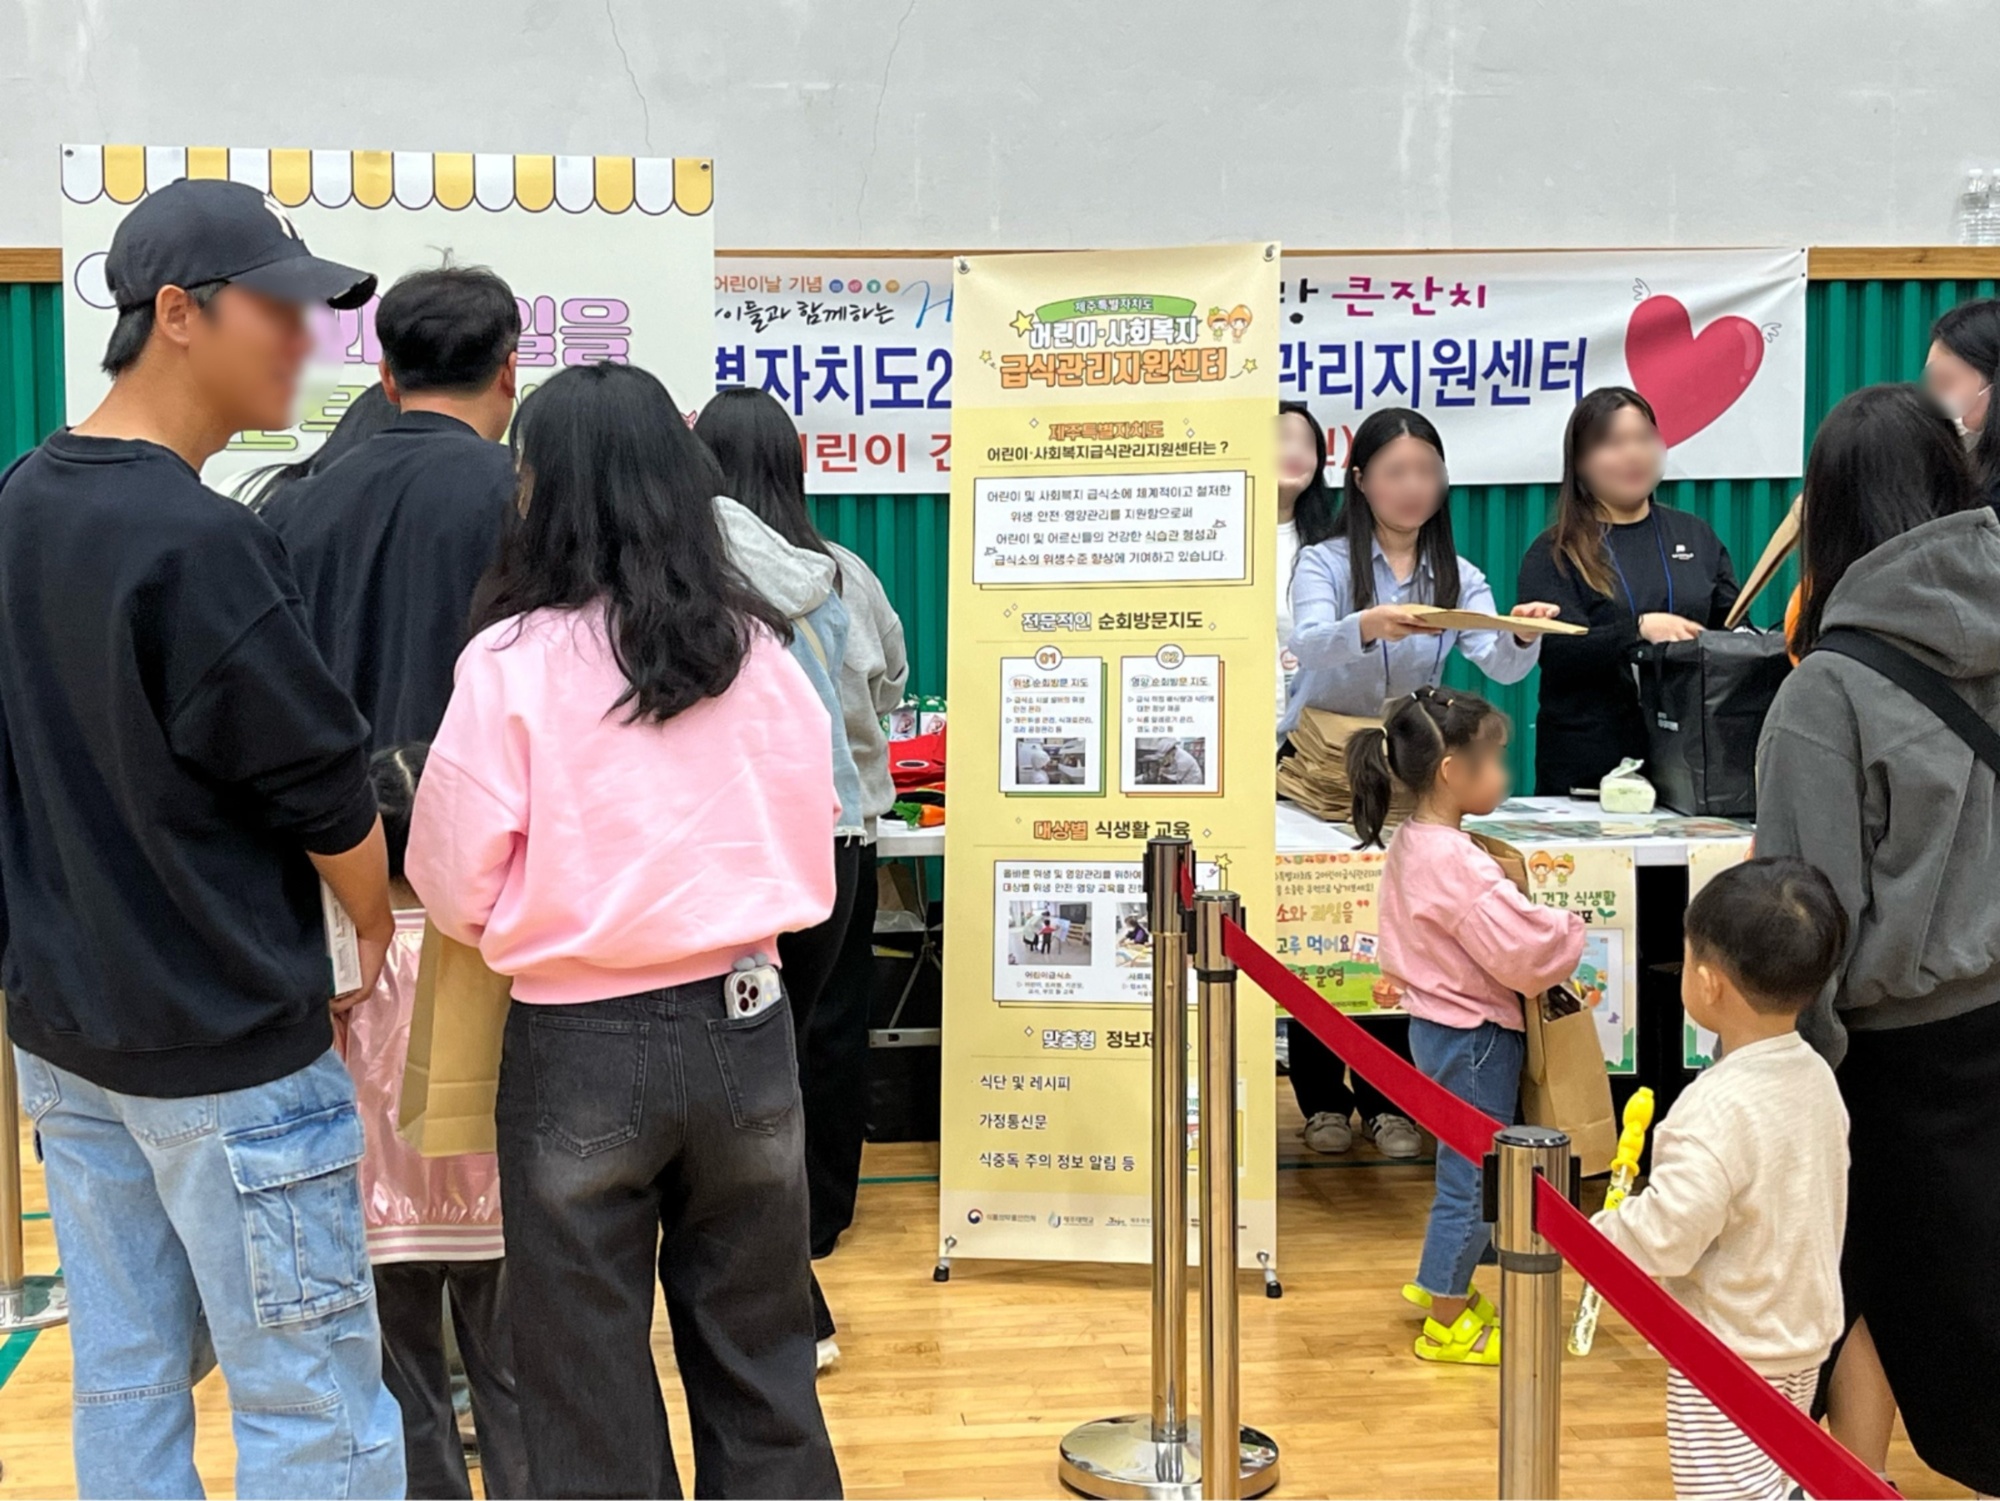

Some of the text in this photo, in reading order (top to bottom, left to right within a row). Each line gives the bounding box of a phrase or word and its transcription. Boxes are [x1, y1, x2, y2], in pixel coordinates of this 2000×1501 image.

[715, 275, 823, 293] 어린이날 기념
[1331, 276, 1487, 317] 큰잔치
[715, 300, 895, 333] 이들과 함께하는
[999, 346, 1229, 389] 급식관리지원센터
[1049, 420, 1165, 441] 제주특별자치도
[987, 485, 1231, 502] 어린이 및 사회복지 급식소에 체계적이고 철저한
[1124, 507, 1193, 520] 지원함으로써
[996, 528, 1217, 545] 어린이 및 어르신들의 건강한 식습관 형성과
[994, 554, 1039, 566] 급식소의
[1043, 553, 1088, 565] 위생수준
[1091, 552, 1126, 565] 향상에
[1129, 552, 1174, 564] 기여하고
[1021, 611, 1203, 632] 전문적인 순회방문지도
[1039, 652, 1057, 664] 01
[1071, 678, 1089, 688] 지도
[1190, 676, 1209, 687] 지도
[1033, 820, 1088, 841] 대상별
[1095, 821, 1150, 839] 식생활
[1033, 869, 1052, 878] 위생
[1542, 891, 1569, 908] 건강
[1574, 890, 1616, 906] 식생활
[1276, 903, 1307, 923] 소와
[1276, 934, 1351, 956] 고루 먹어요
[1315, 966, 1345, 988] 운영
[1042, 1029, 1096, 1050] 맞춤형
[980, 1075, 1071, 1091] 식단 및 레시피
[979, 1114, 1048, 1130] 가정통신문
[979, 1152, 1135, 1171] 식중독 주의 정보 알림 등
